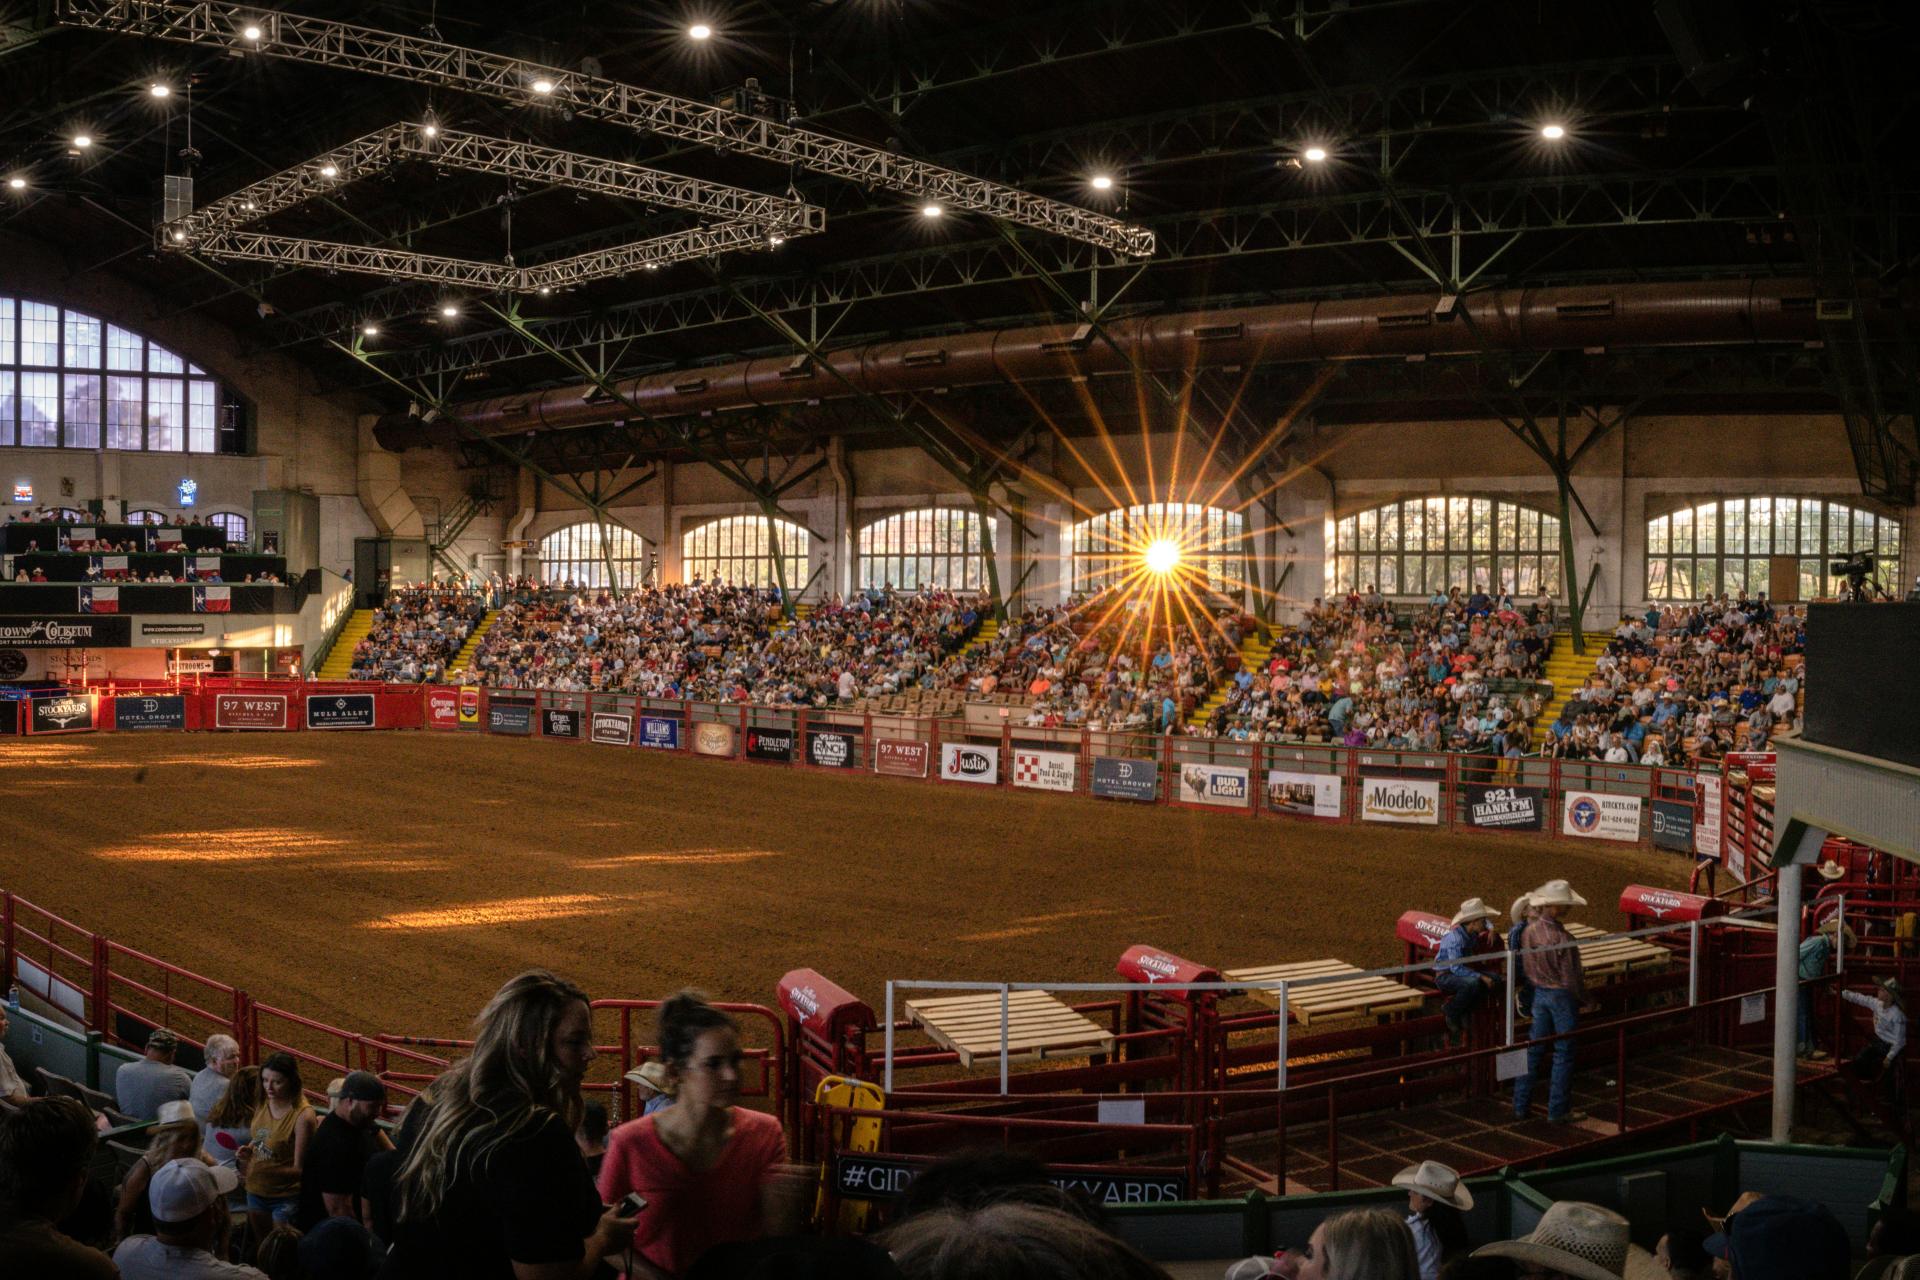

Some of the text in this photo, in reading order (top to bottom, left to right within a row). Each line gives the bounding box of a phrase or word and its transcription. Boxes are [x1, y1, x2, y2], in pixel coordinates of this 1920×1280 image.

[38, 703, 87, 717] STOCKYARDS
[223, 701, 281, 711] 97 WEST
[758, 735, 790, 750] PENDLETON
[815, 742, 845, 754] RANCH
[881, 744, 923, 757] 97 WEST
[947, 749, 988, 775] Justin
[1097, 777, 1152, 788] HOTEL DROVER
[1216, 775, 1239, 787] BUD
[1211, 785, 1243, 797] LIGHT
[1374, 786, 1426, 810] Modelo
[1484, 787, 1516, 803] 92.1
[1475, 799, 1530, 817] HANK FM
[1638, 893, 1681, 908] STOCKYARDS
